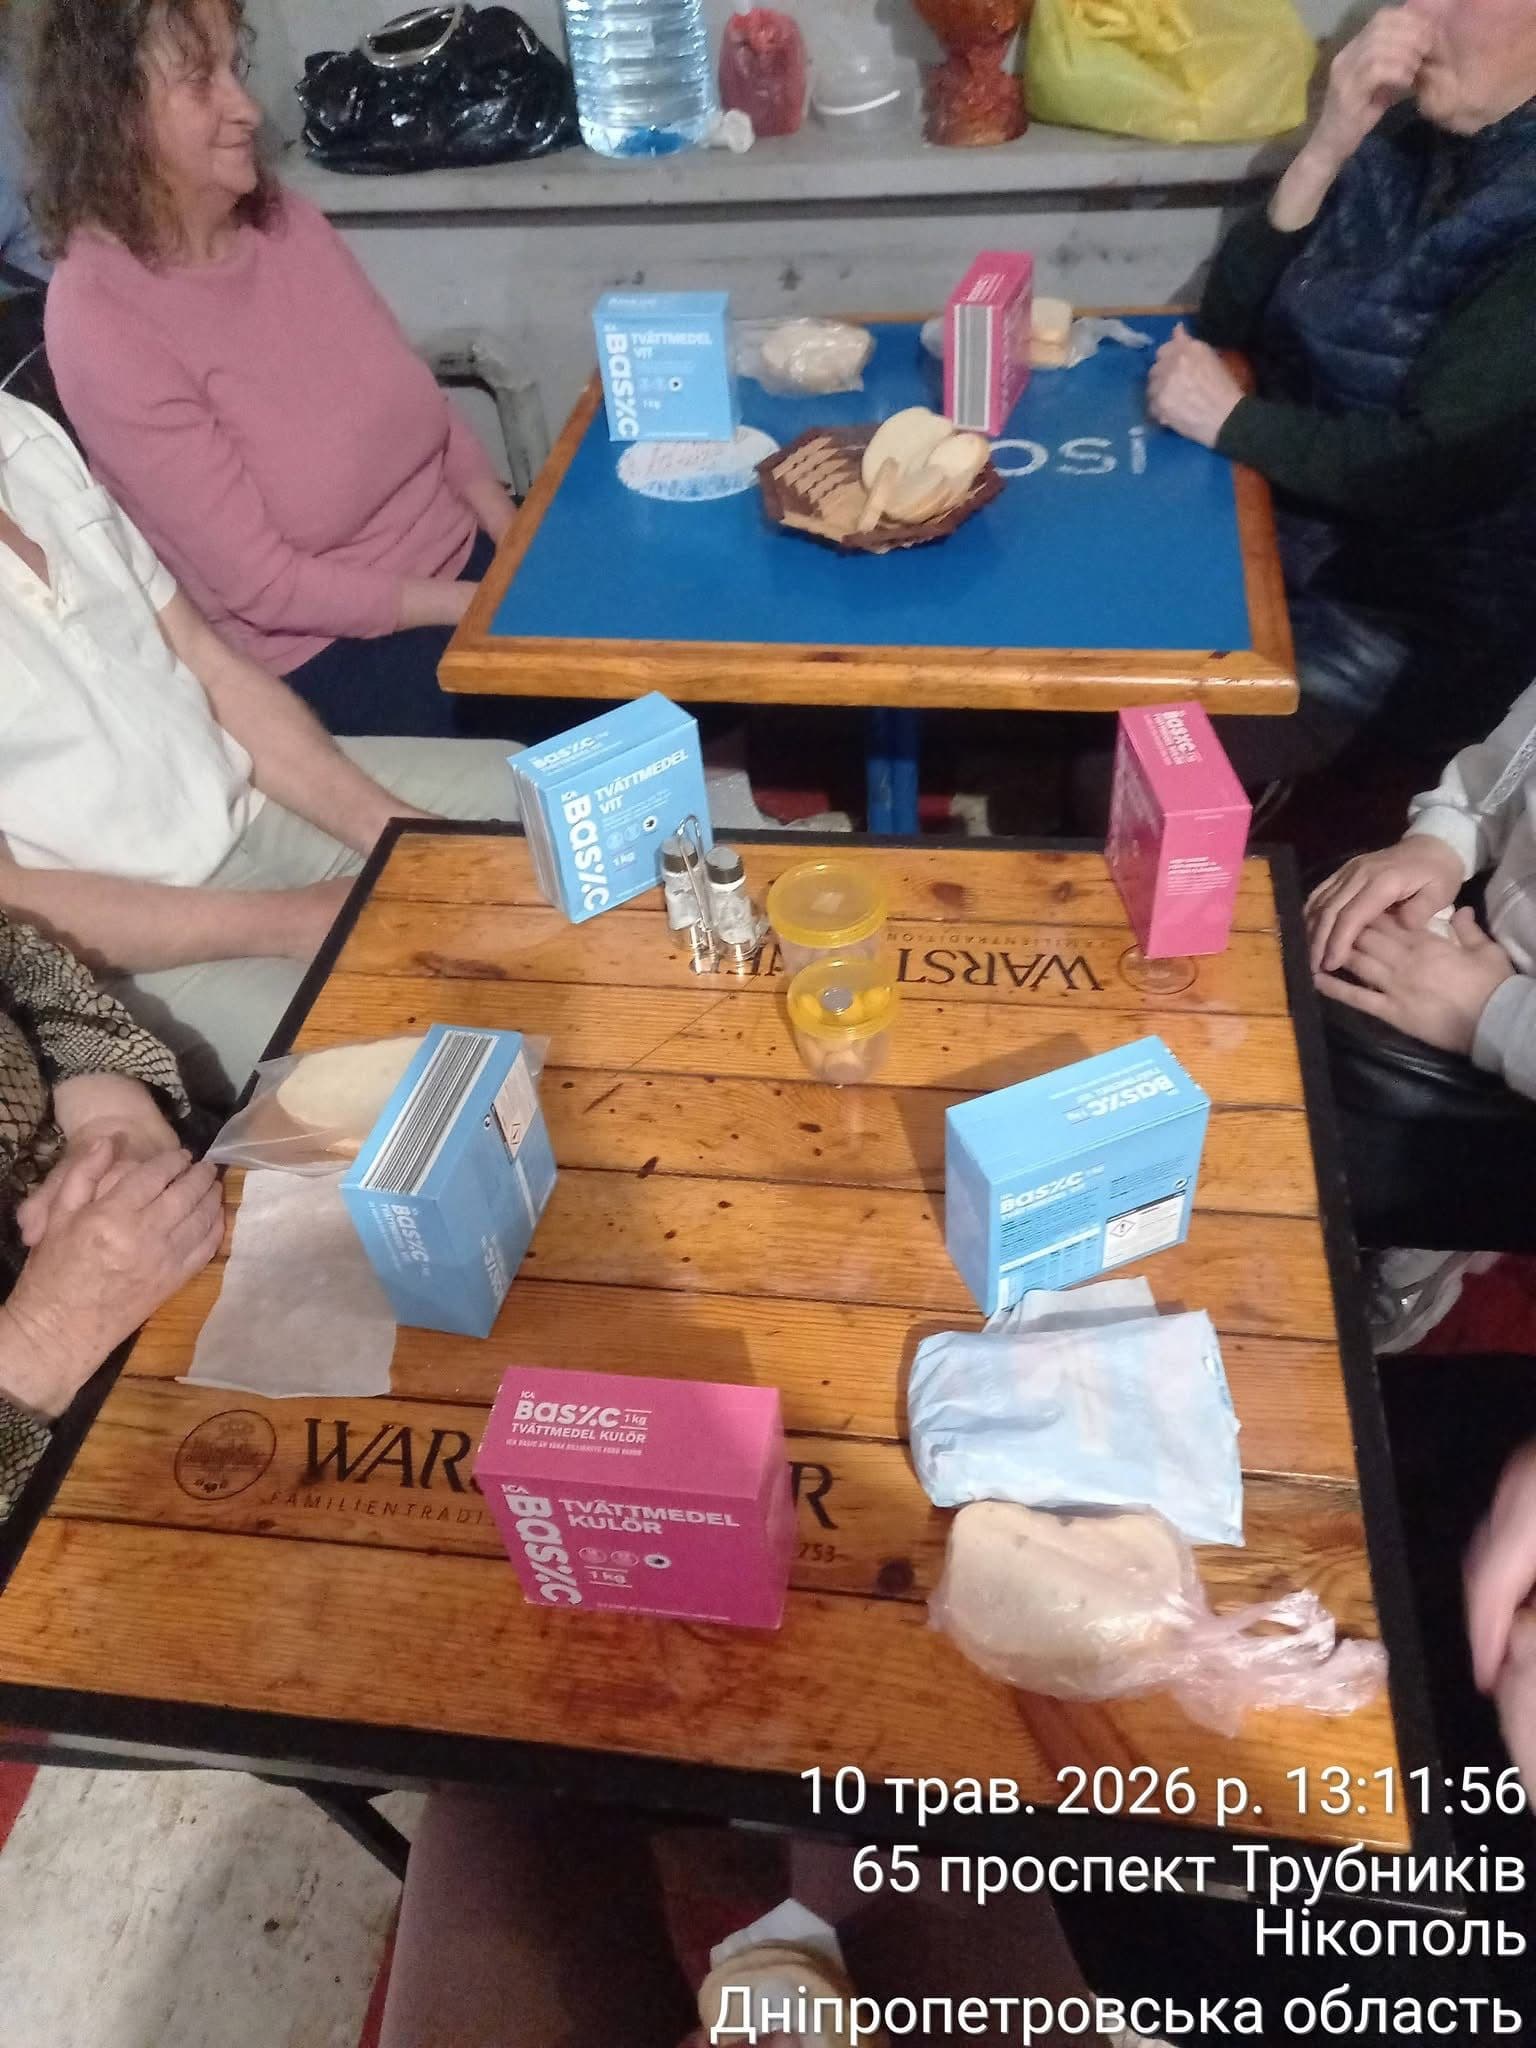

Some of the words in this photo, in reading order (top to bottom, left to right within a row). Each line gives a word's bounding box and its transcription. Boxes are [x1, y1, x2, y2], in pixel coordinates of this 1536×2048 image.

[594, 748, 690, 802] TVÄTTMEDEL
[600, 794, 625, 815] VIT
[632, 1414, 648, 1426] kg
[511, 1422, 596, 1440] TVÄTTMEDEL
[600, 1430, 647, 1444] KULÖR
[270, 1490, 494, 1526] FAMILIENTRADI
[558, 1499, 741, 1528] TVÄTTMEDEL
[567, 1513, 664, 1535] KULÖR
[602, 1572, 627, 1584] kg
